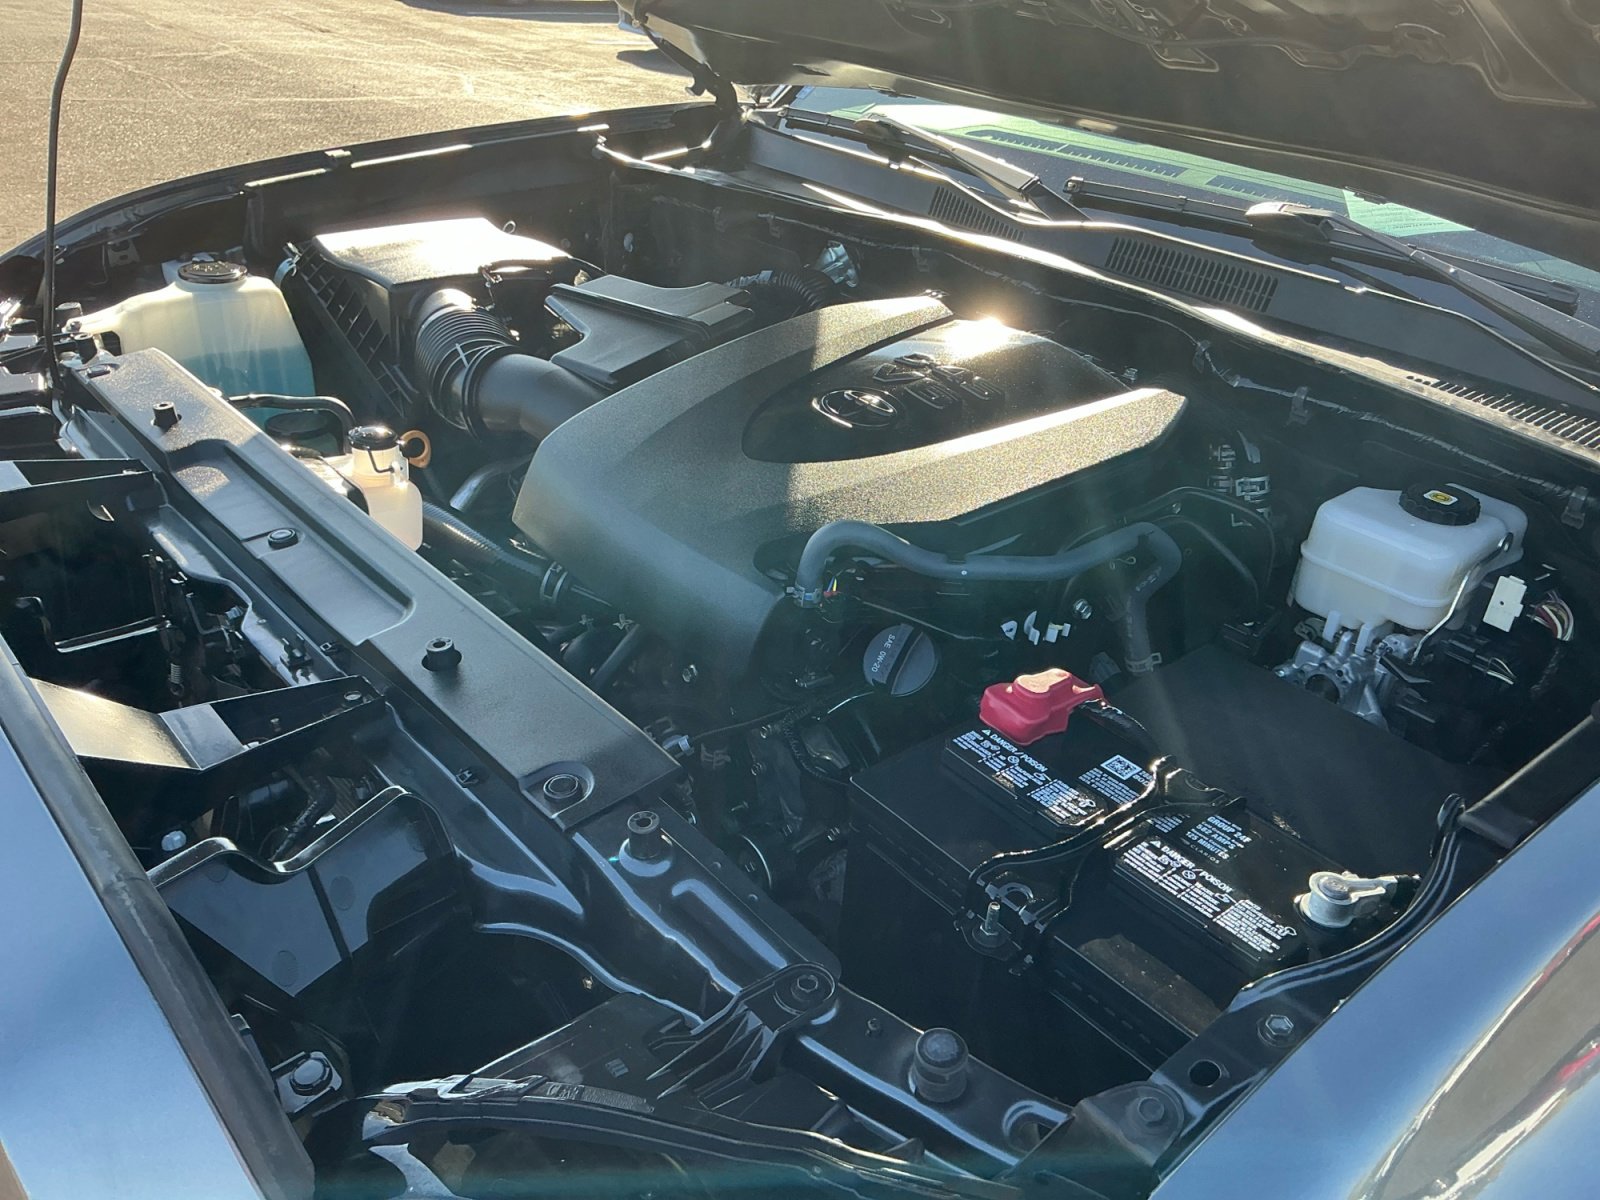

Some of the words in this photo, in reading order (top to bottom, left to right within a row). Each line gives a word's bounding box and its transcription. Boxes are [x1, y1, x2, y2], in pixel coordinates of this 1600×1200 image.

[884, 634, 896, 649] SAE
[871, 651, 887, 673] 0W-20
[989, 733, 1018, 755] DANGER
[1020, 752, 1048, 772] POISON
[1196, 824, 1213, 835] 582
[1211, 833, 1236, 849] AMPS
[1207, 816, 1236, 833] GROUP
[1233, 831, 1252, 843] 24F
[1186, 831, 1199, 841] 125
[1197, 838, 1230, 860] MINUTES
[1190, 844, 1220, 864] CLARIOS
[1160, 845, 1195, 869] DANGER
[1199, 869, 1233, 894] POISON
